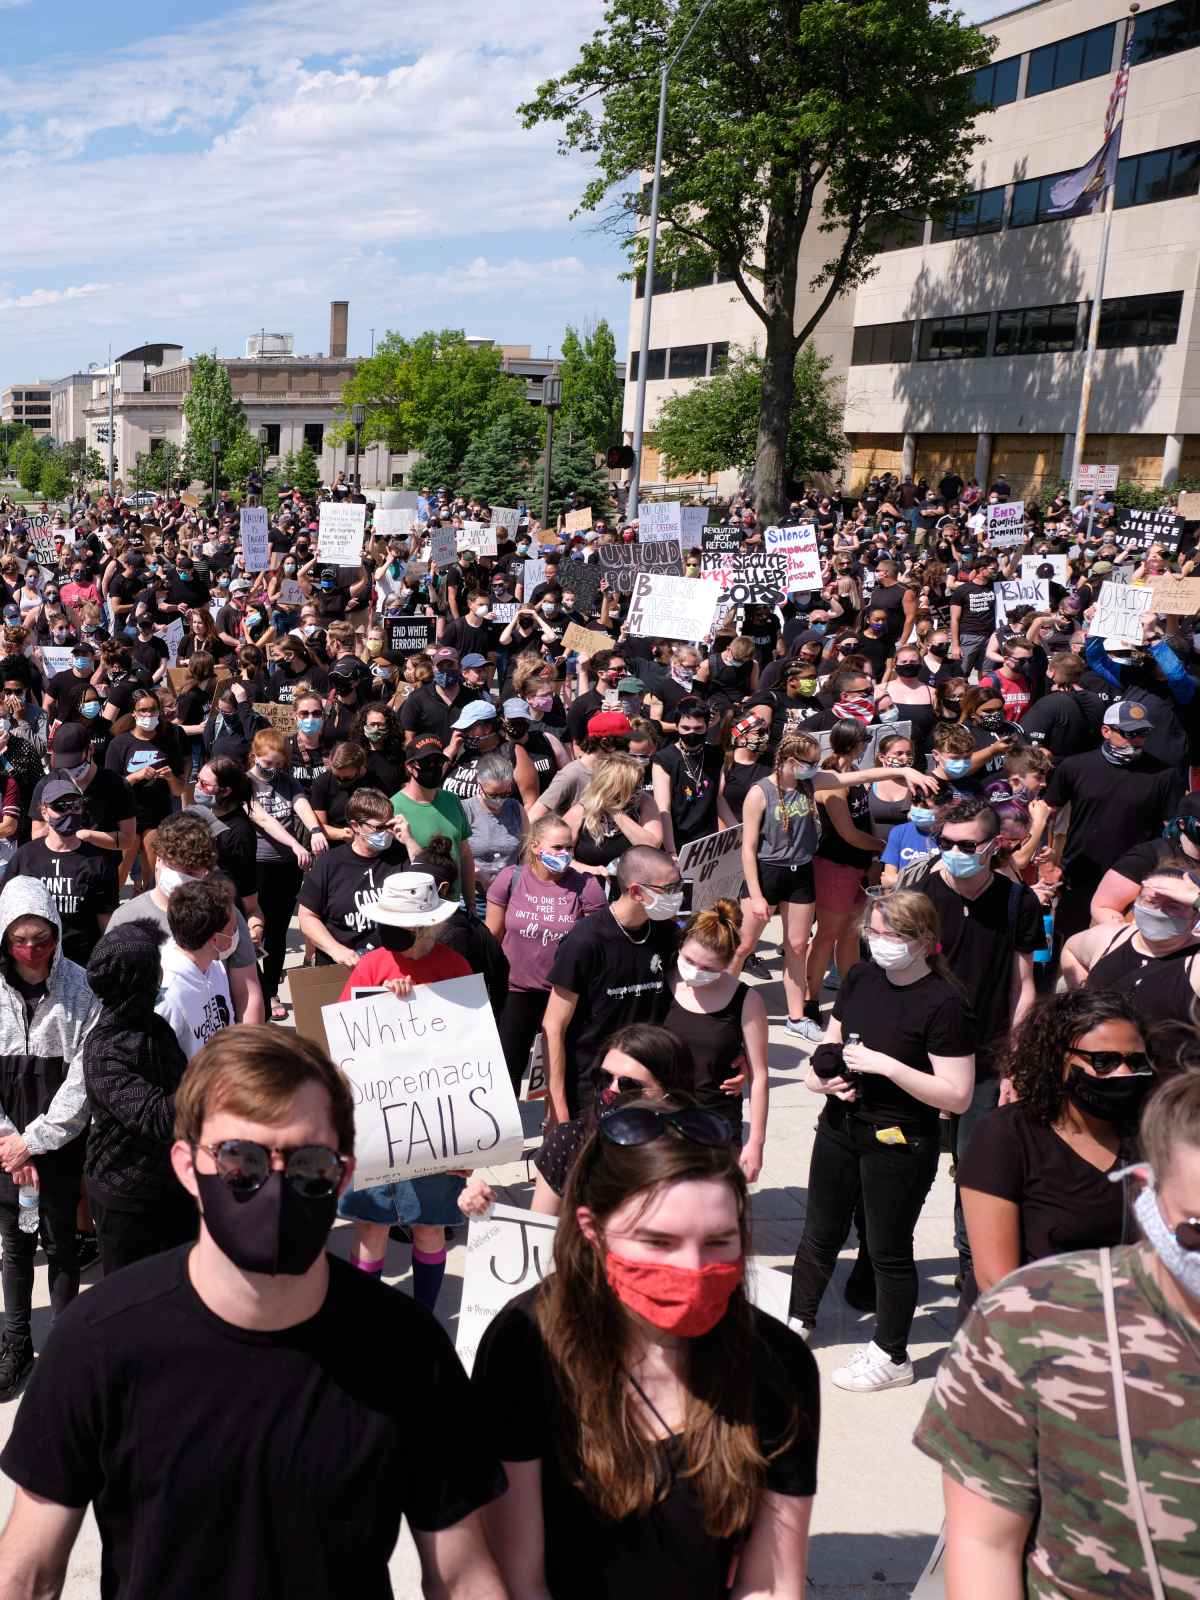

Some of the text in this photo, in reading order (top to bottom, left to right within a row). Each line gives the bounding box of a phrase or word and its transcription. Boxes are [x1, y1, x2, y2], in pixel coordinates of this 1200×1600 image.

[22, 515, 49, 530] STOP
[1131, 510, 1176, 524] WHITE
[703, 526, 740, 534] REVOLUTION
[1120, 520, 1180, 536] SILENCE
[714, 534, 731, 542] NOT
[766, 530, 811, 544] Silence
[705, 541, 740, 550] REFORM
[599, 542, 681, 567] UNFUND
[393, 625, 428, 638] END WHITE
[392, 638, 428, 650] TERRORISM
[699, 860, 720, 881] UP
[540, 895, 555, 906] ONE
[515, 909, 576, 923] UNTIL WE ARE
[338, 1010, 448, 1052] White
[340, 1056, 495, 1111] Supremacy
[381, 1085, 502, 1169] FAILS
